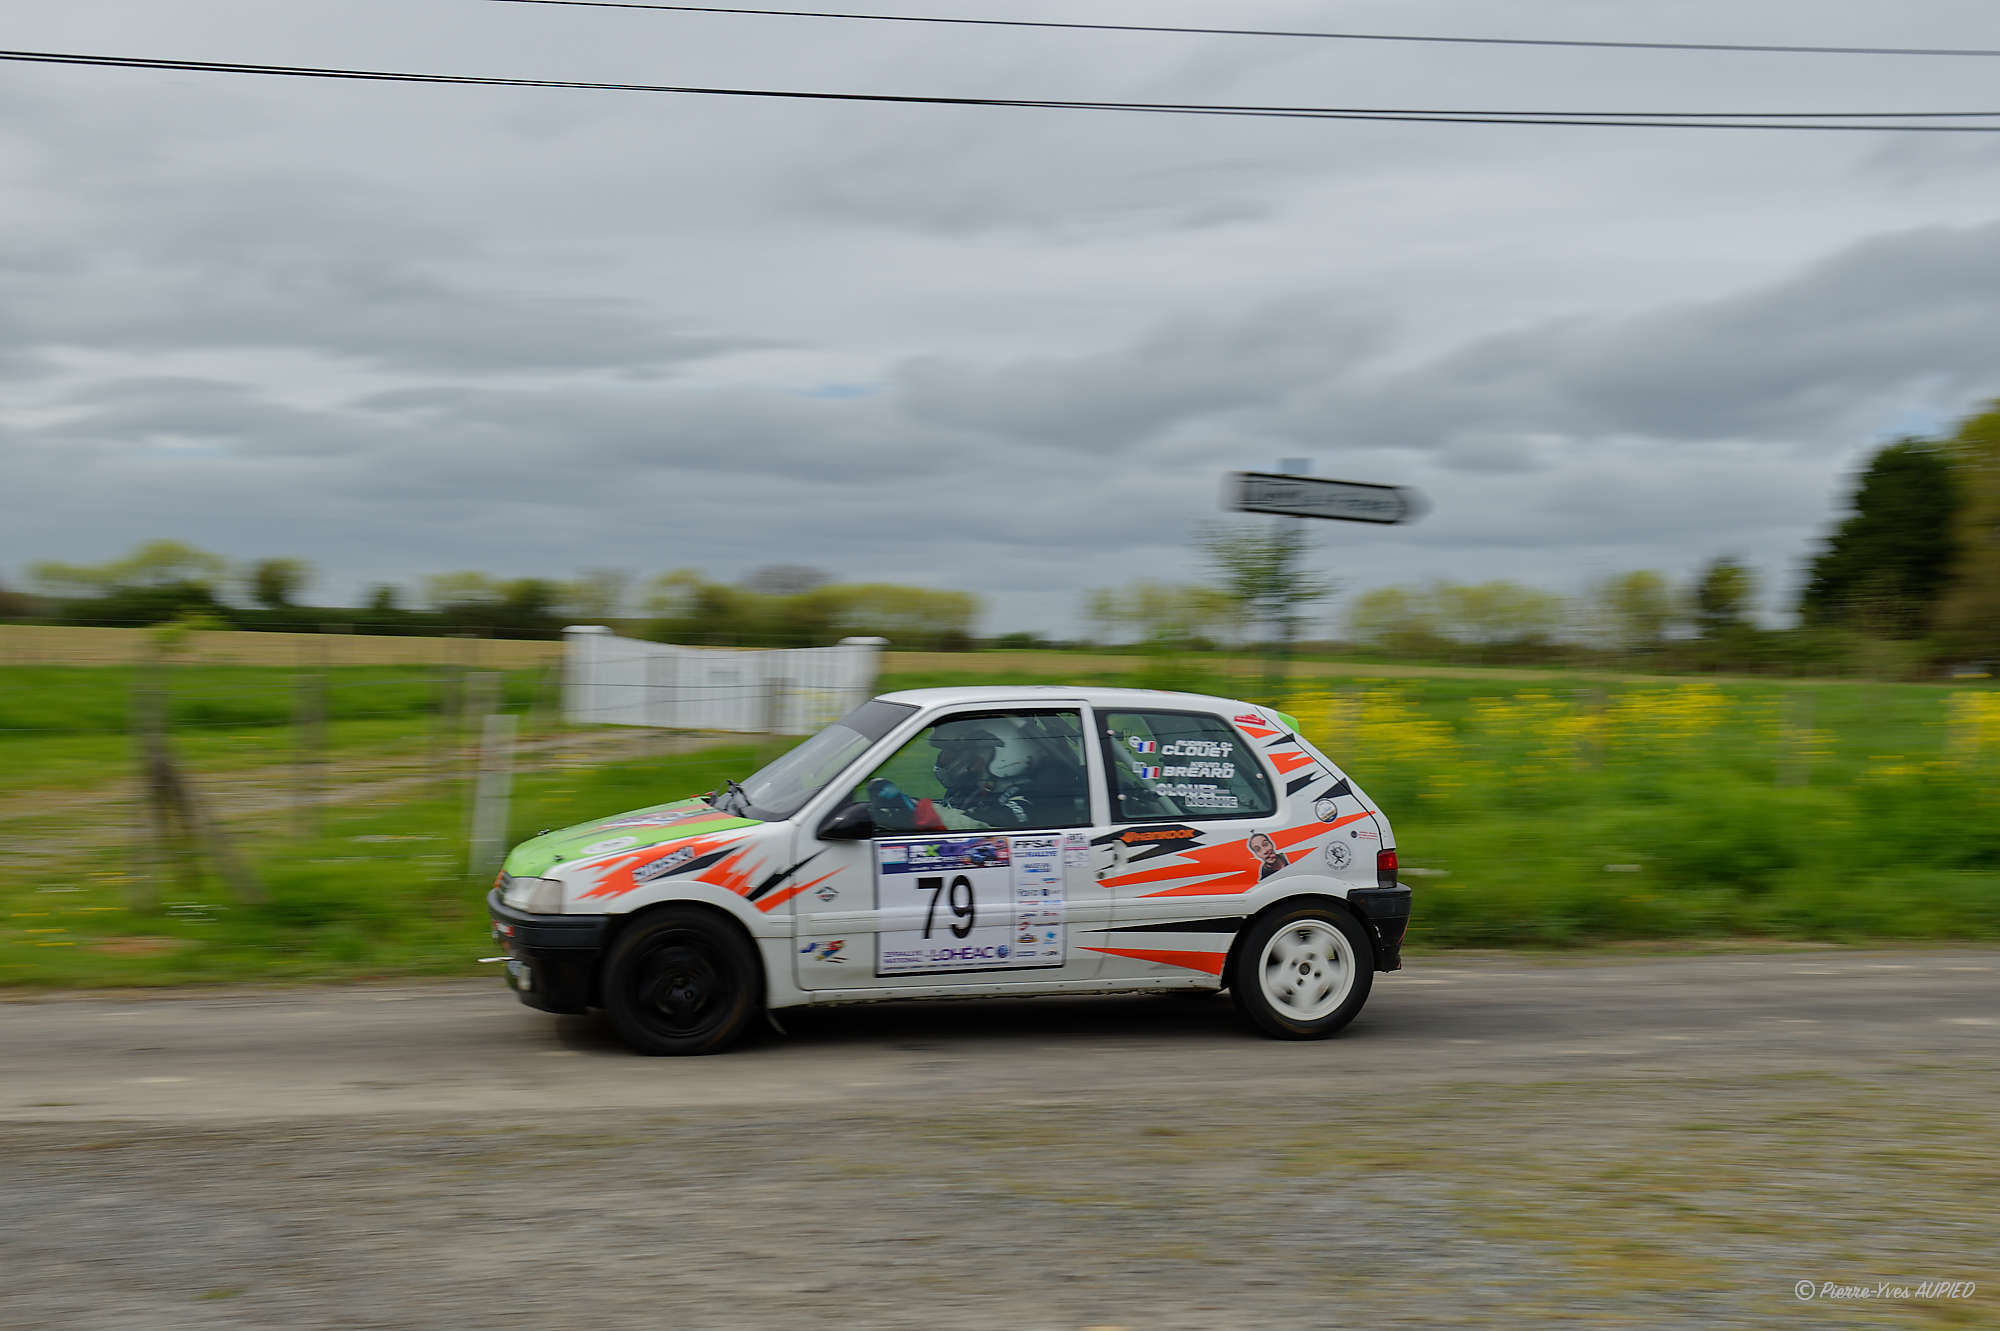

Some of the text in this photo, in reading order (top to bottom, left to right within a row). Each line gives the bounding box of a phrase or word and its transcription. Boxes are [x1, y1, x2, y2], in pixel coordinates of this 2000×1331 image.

[1161, 745, 1233, 757] CLOUET
[1162, 766, 1235, 778] BREARD
[1013, 839, 1056, 849] FFSA
[915, 874, 975, 939] 79
